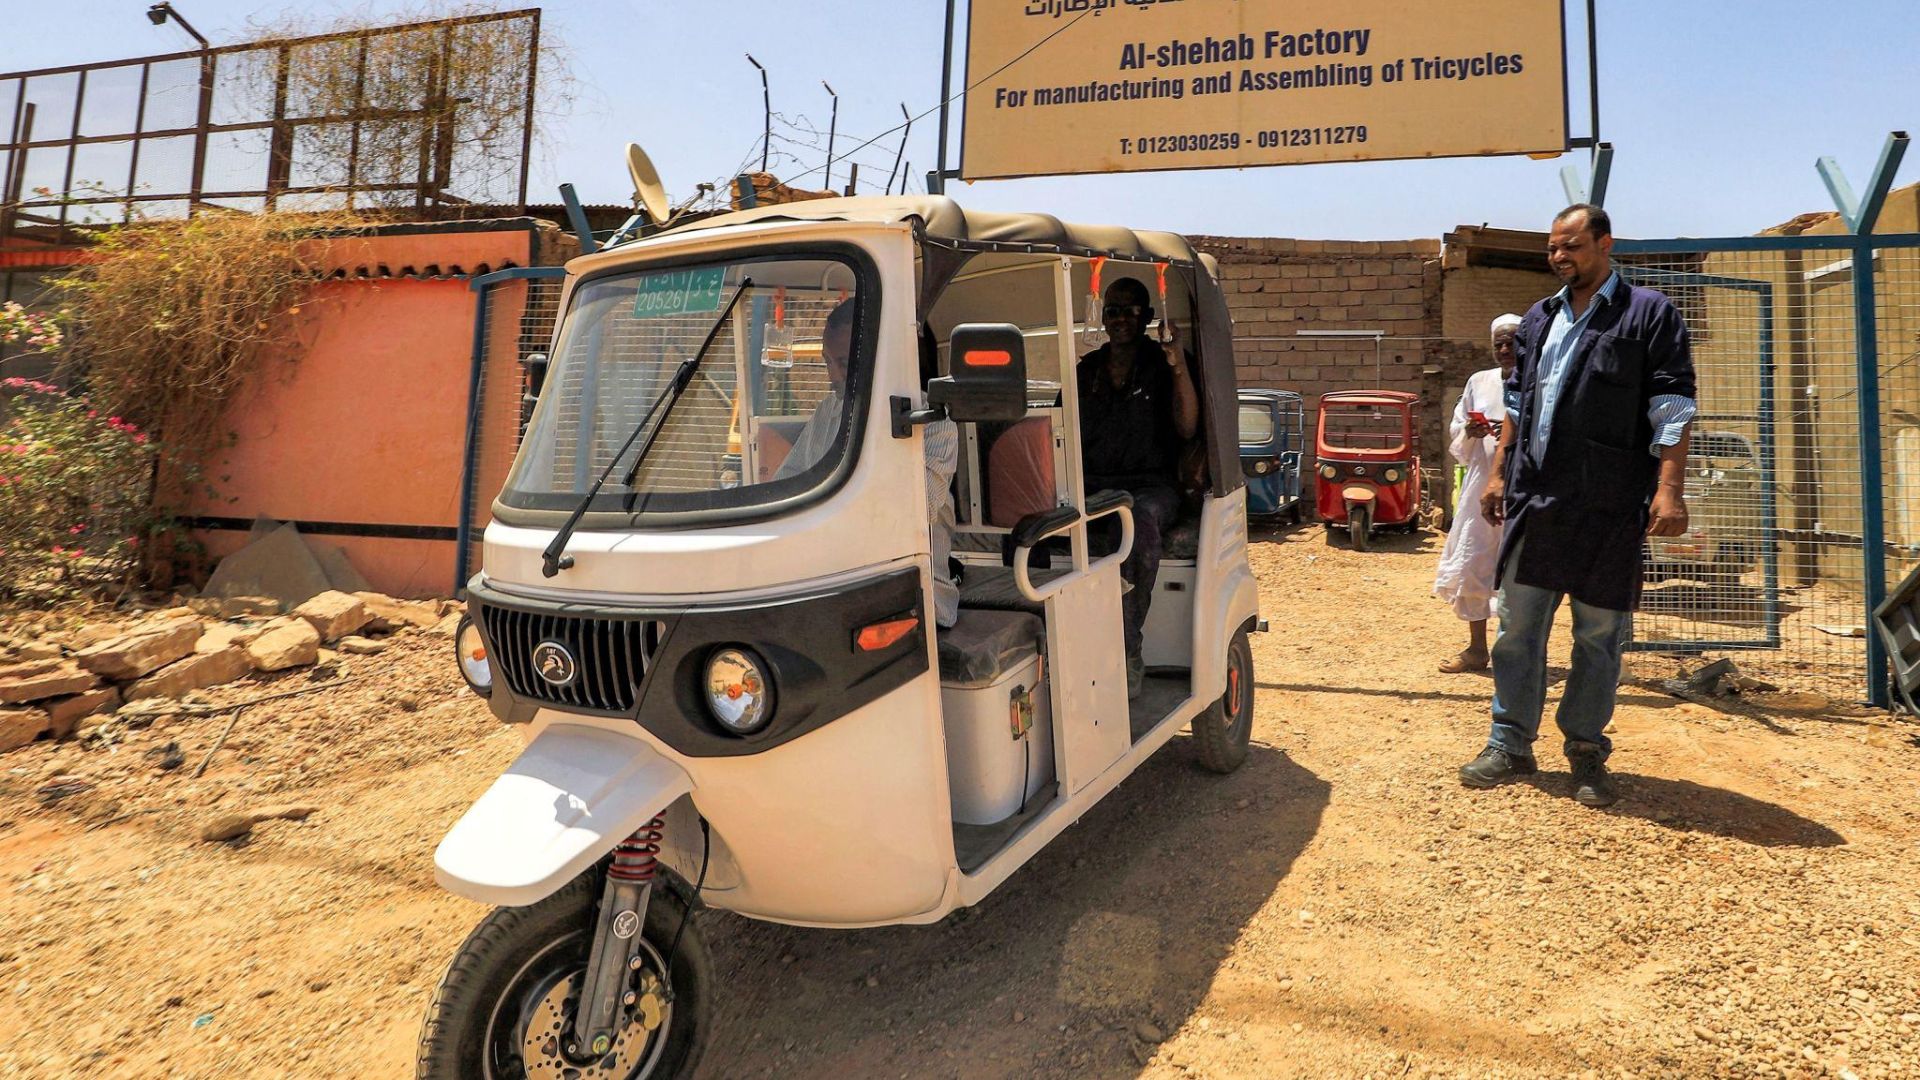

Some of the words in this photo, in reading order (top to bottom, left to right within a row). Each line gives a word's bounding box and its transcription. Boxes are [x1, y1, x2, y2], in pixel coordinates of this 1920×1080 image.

[1119, 34, 1254, 71] Al-shehab
[1264, 28, 1371, 59] Factory
[995, 87, 1028, 109] For
[1033, 79, 1184, 106] manufacturing
[1191, 72, 1232, 96] and
[1239, 63, 1373, 92] Assembling
[1381, 58, 1404, 83] of
[1412, 51, 1525, 81] Tricycles
[1119, 138, 1134, 155] T:
[1137, 132, 1240, 154] 0123030259
[1258, 125, 1367, 149] 0912311279
[638, 290, 682, 312] 20526
